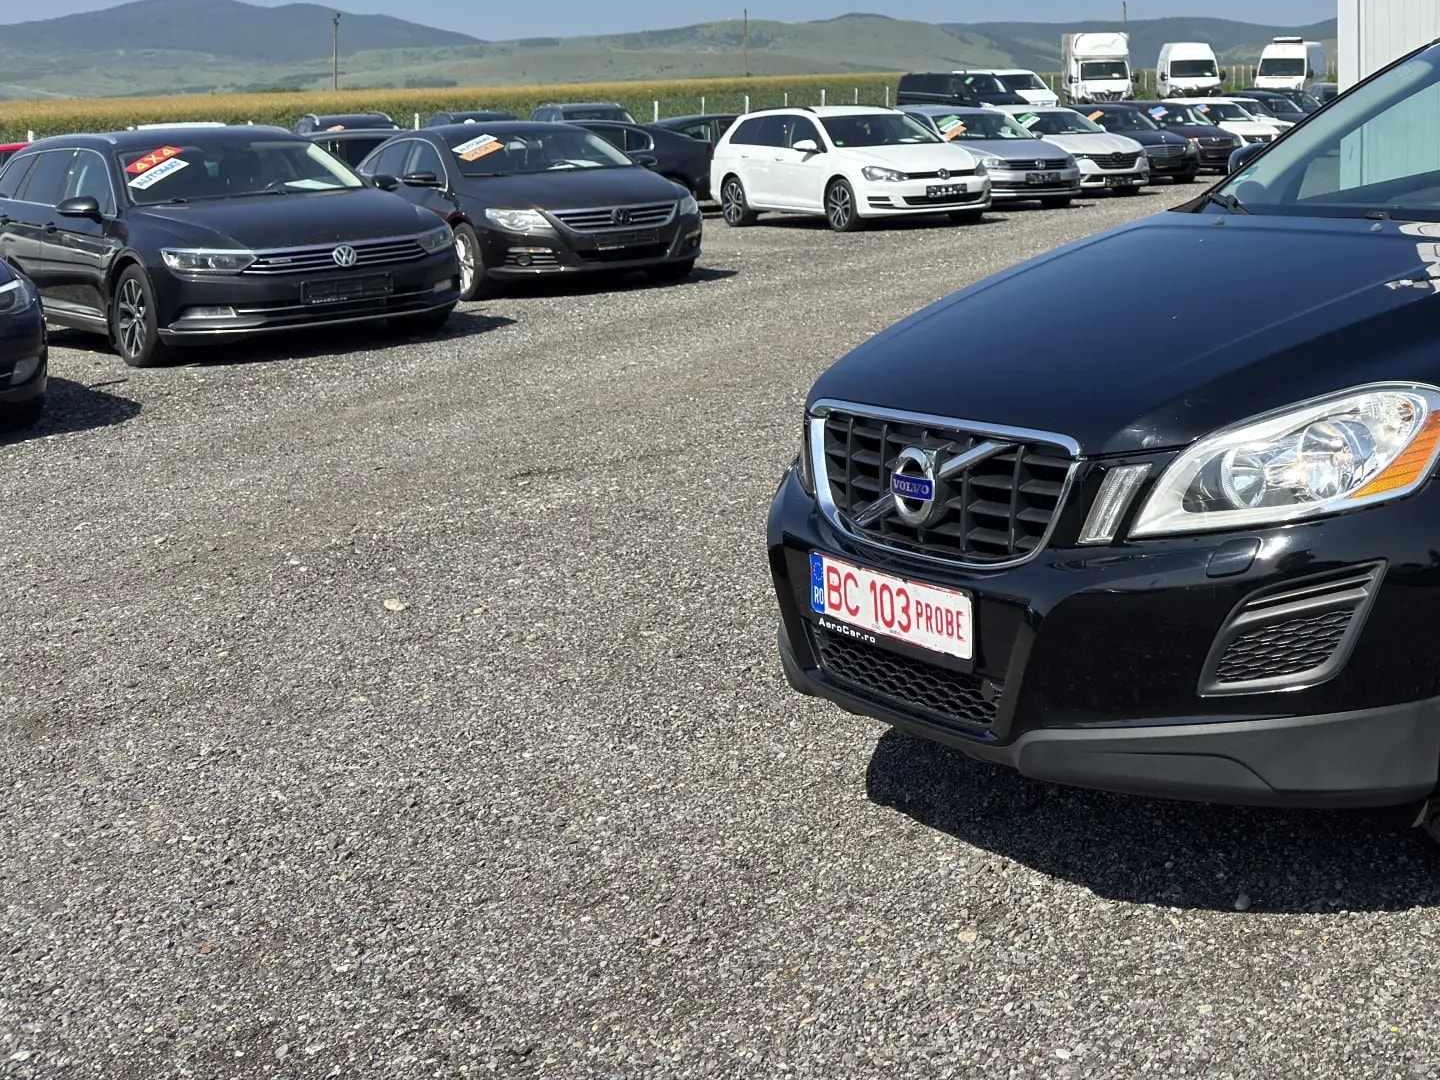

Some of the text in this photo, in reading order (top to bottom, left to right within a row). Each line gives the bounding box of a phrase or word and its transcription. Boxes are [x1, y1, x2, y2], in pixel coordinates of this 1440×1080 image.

[893, 478, 930, 495] VOLVO
[814, 586, 824, 605] RO
[826, 565, 966, 641] BC 103 PROBE
[818, 617, 876, 643] AeroCar.ro
